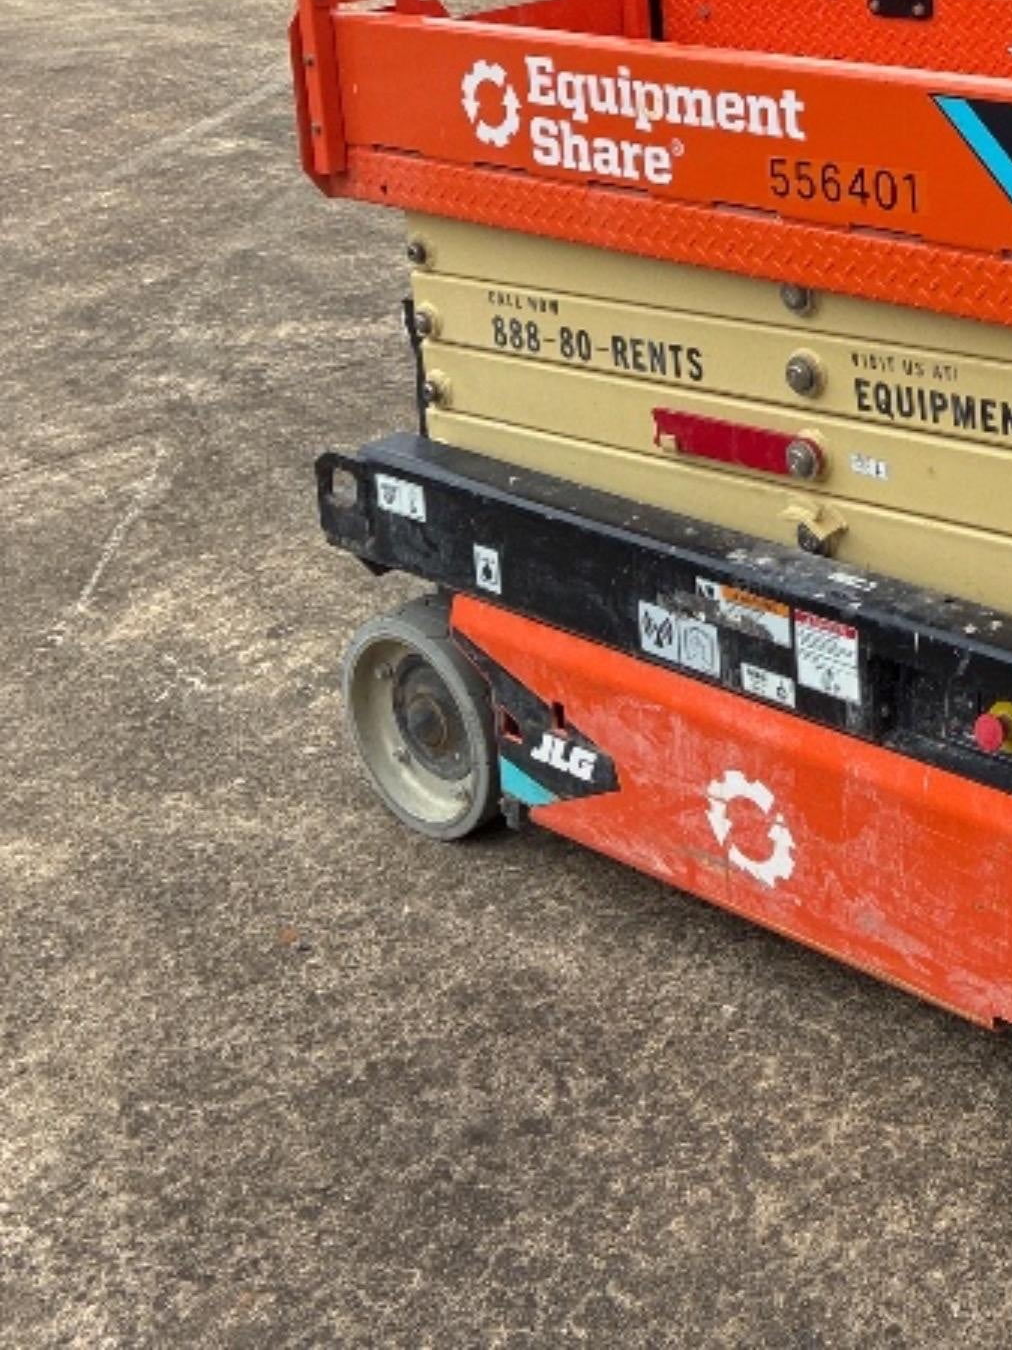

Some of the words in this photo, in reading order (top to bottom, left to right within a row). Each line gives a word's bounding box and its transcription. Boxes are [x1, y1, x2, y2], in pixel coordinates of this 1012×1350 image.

[525, 56, 807, 141] Equipment
[769, 157, 920, 213] 556401
[491, 315, 704, 381] 888-80-RENTS
[530, 733, 598, 783] JLG
